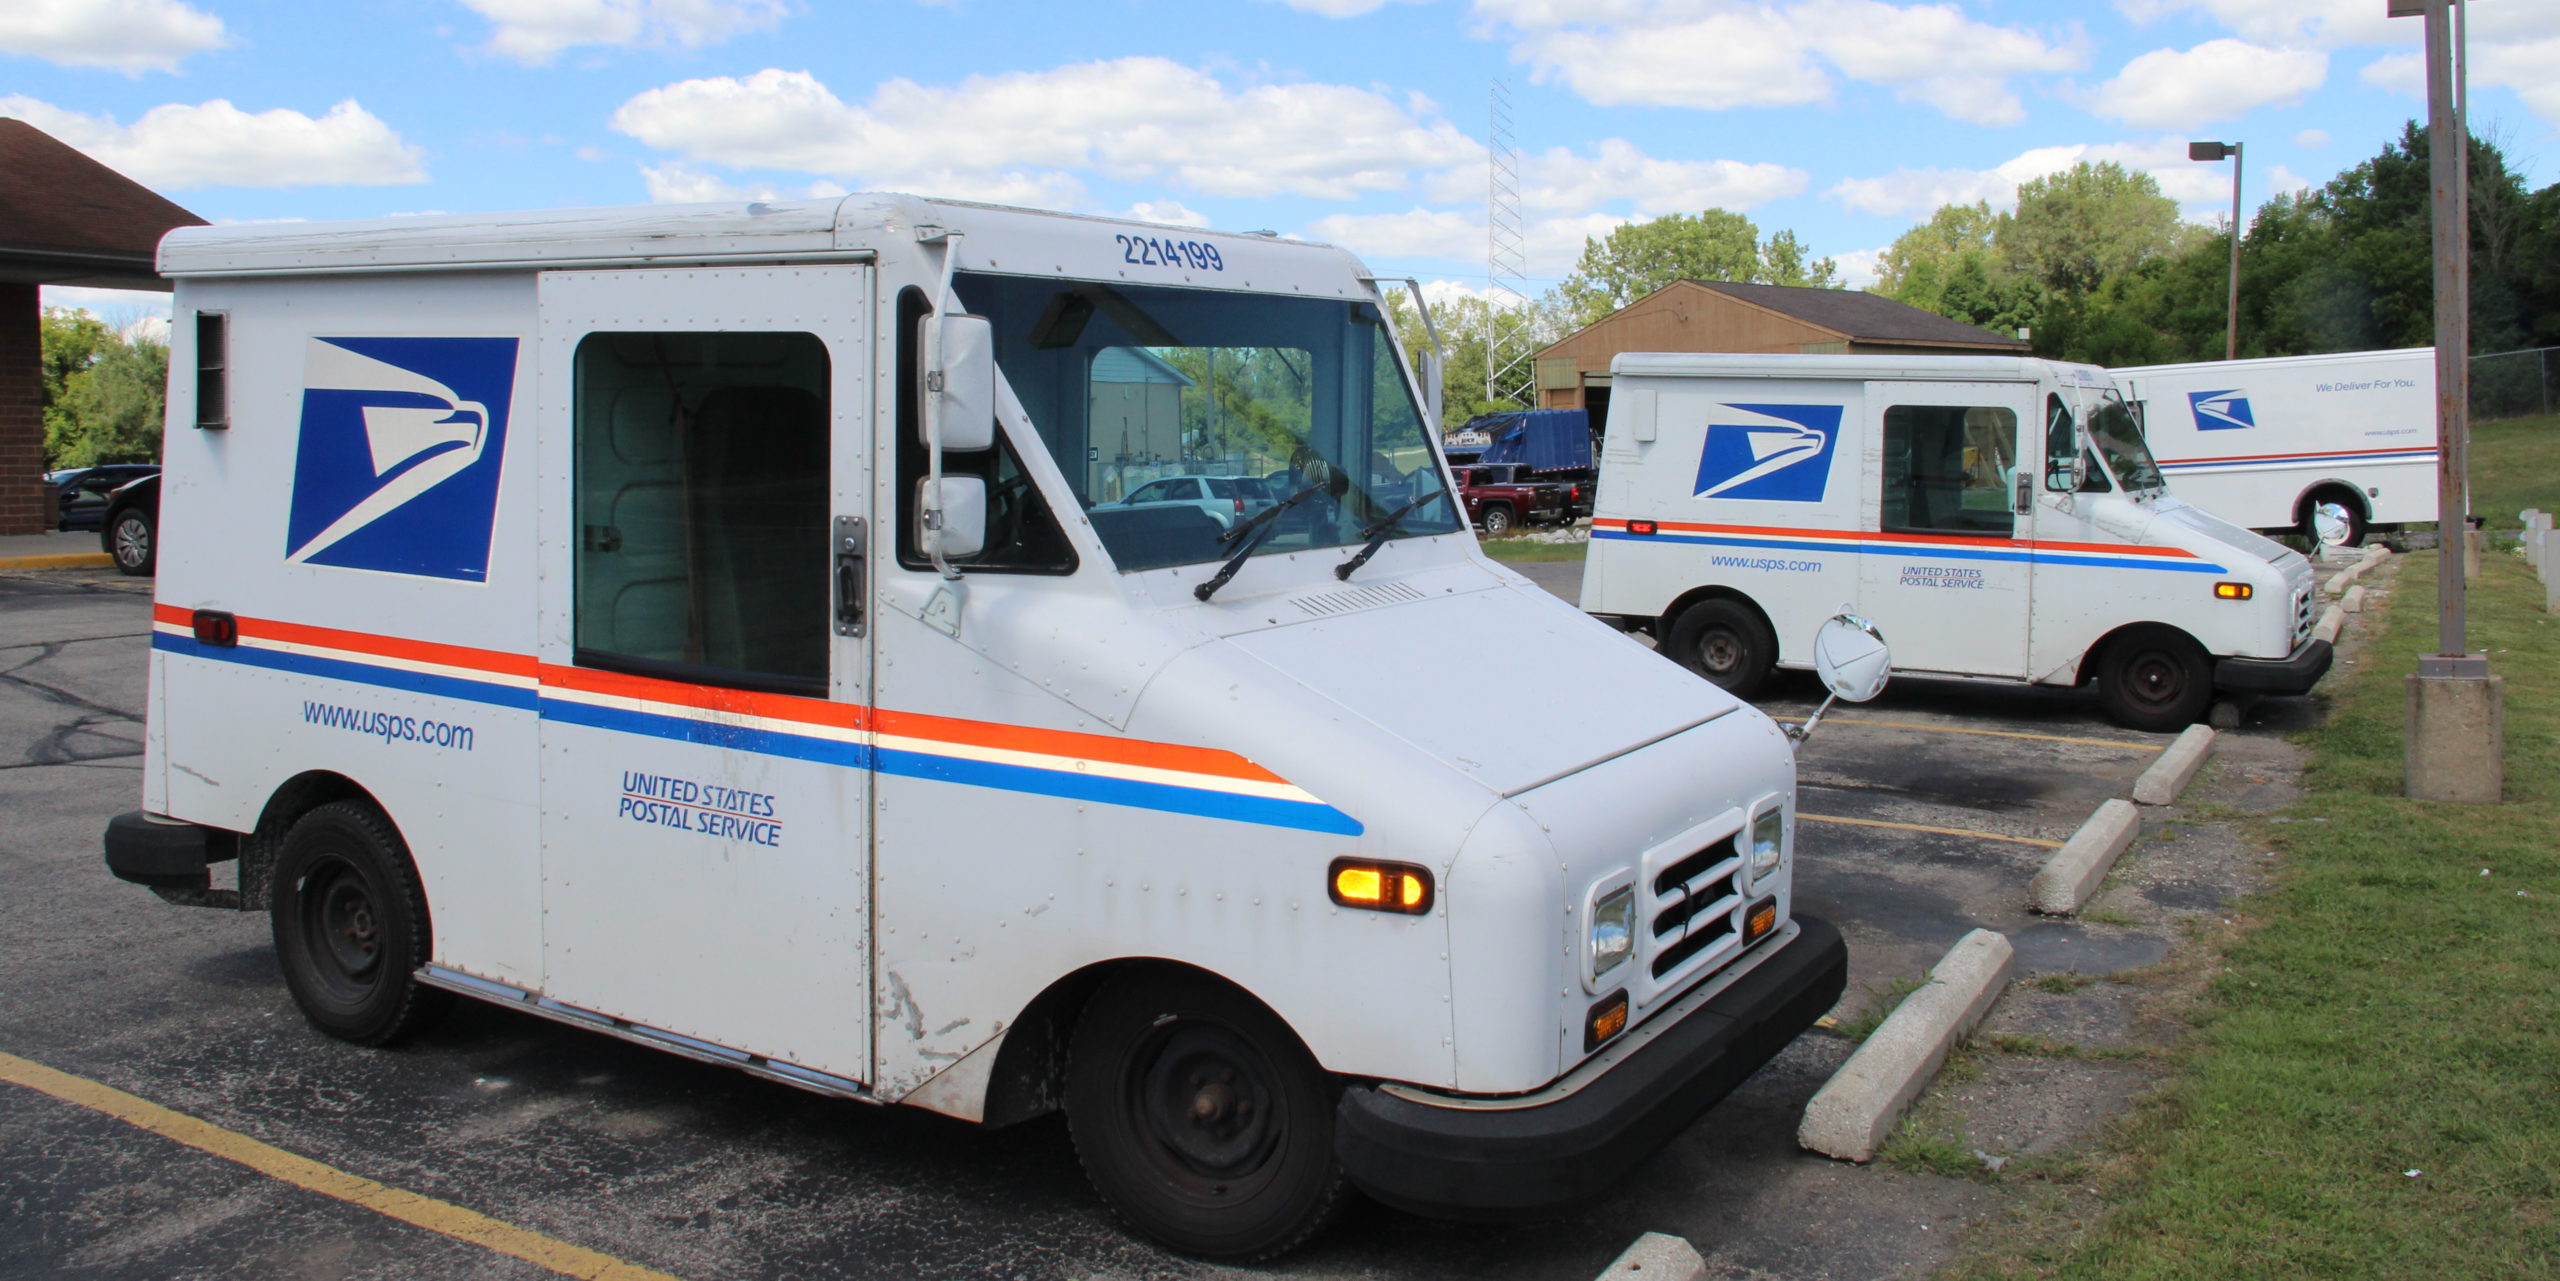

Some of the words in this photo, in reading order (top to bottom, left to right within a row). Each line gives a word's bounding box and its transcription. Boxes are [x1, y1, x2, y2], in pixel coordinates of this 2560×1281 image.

[1115, 234, 1223, 271] 2214199
[2316, 383, 2333, 392] We
[2334, 381, 2372, 392] Deliver
[2373, 380, 2391, 389] For
[2394, 379, 2416, 388] You.
[1711, 555, 1822, 572] www.usps.com
[1902, 566, 1943, 577] UNITED
[1944, 568, 1982, 579] STATES
[1900, 576, 1939, 587] POSTAL
[1941, 579, 1985, 590] SERVICE
[303, 700, 474, 751] www.usps.com
[623, 771, 699, 803] UNITED
[702, 785, 775, 817] STATES
[619, 797, 693, 831] POSTAL
[697, 812, 782, 847] SERVICE
